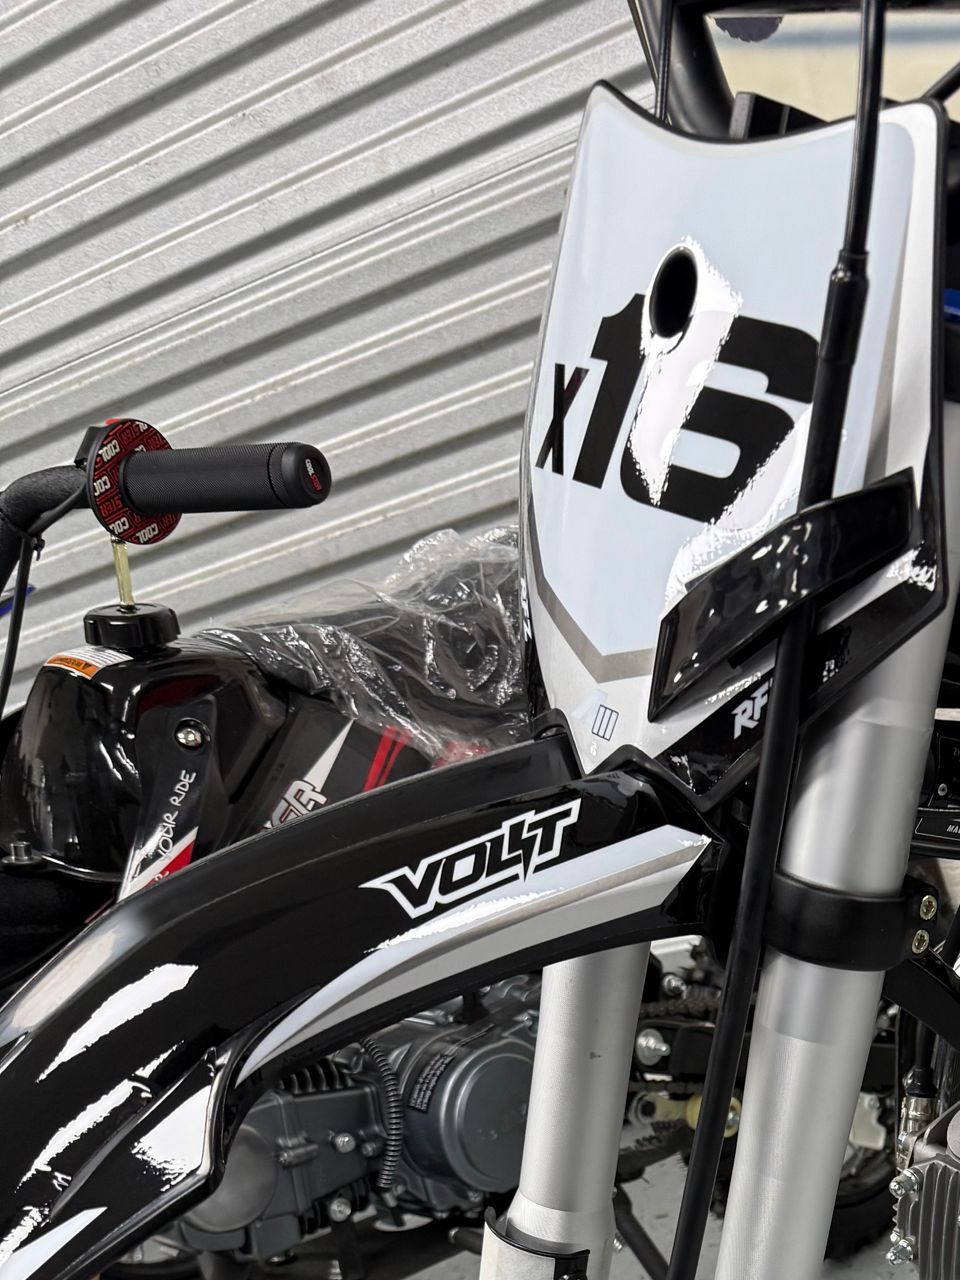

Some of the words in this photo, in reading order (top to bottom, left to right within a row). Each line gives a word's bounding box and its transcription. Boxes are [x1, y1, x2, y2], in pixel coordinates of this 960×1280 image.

[98, 440, 120, 462] COOL
[136, 523, 159, 543] COOL
[732, 681, 773, 739] RF
[171, 770, 196, 807] RIDE
[358, 798, 582, 919] VOLT
